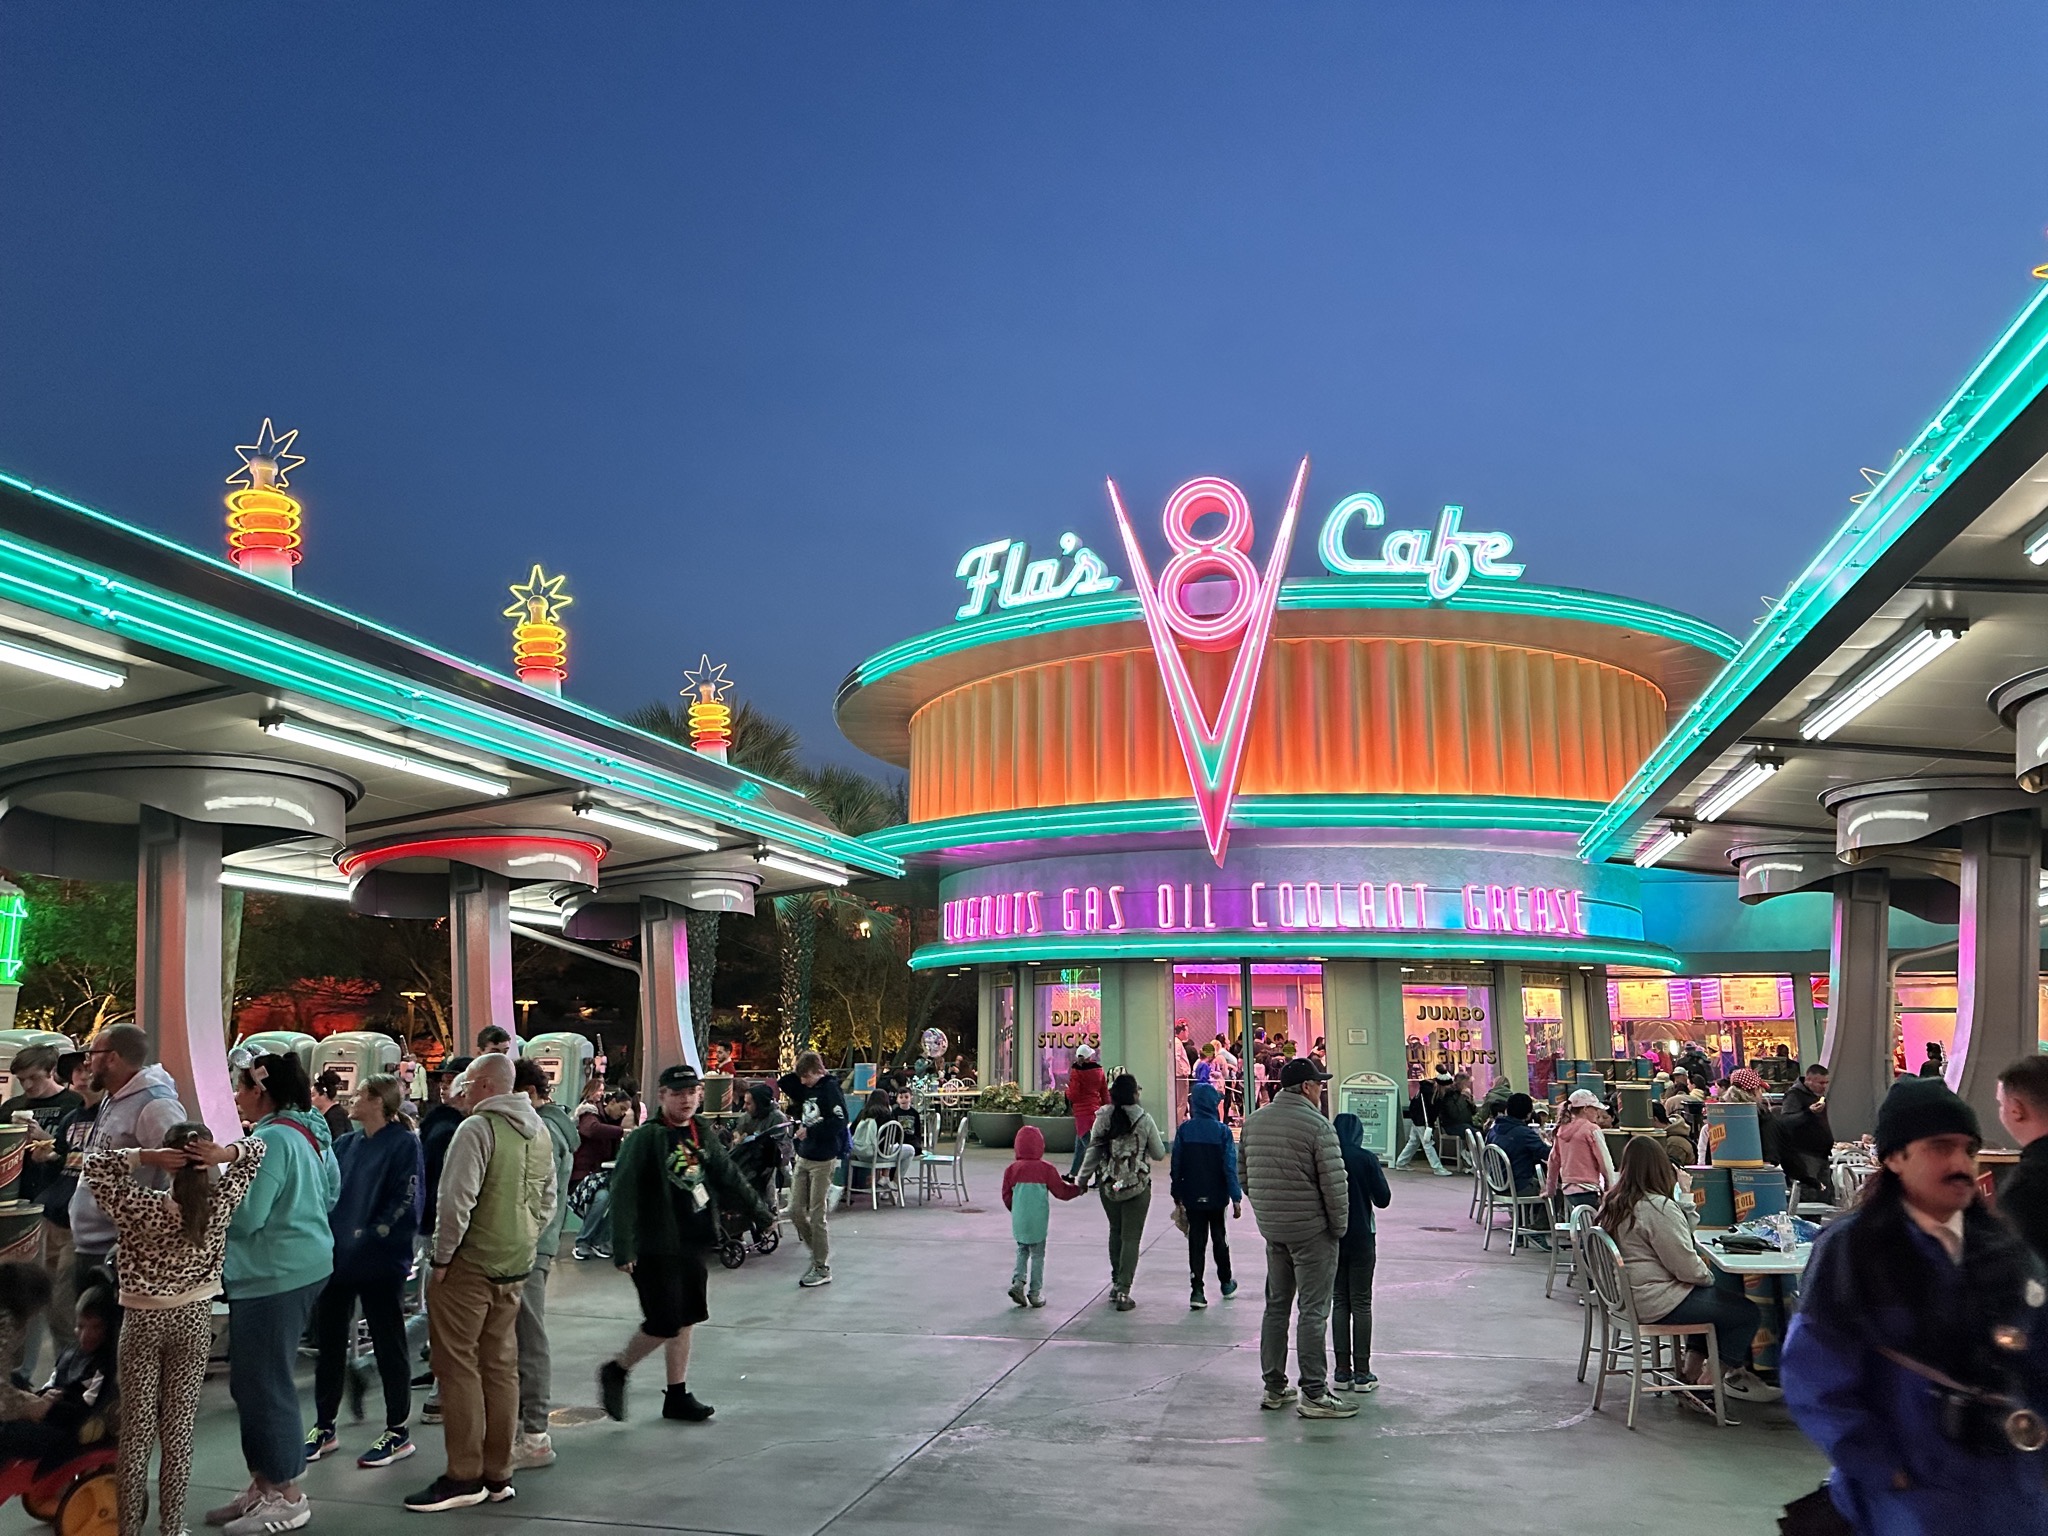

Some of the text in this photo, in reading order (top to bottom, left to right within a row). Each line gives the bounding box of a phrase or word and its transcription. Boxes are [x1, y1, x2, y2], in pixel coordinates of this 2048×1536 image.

[955, 532, 1123, 621] Flo's
[1318, 492, 1526, 600] Cafe
[943, 881, 1587, 941] LUGNUTS GAS OIL COOLANT GREASE
[1051, 1010, 1081, 1026] DIP
[1416, 1005, 1485, 1021] JUMBO
[1038, 1032, 1100, 1048] STICKS
[1436, 1027, 1471, 1042] BIG
[1406, 1049, 1497, 1064] LUGNUTS
